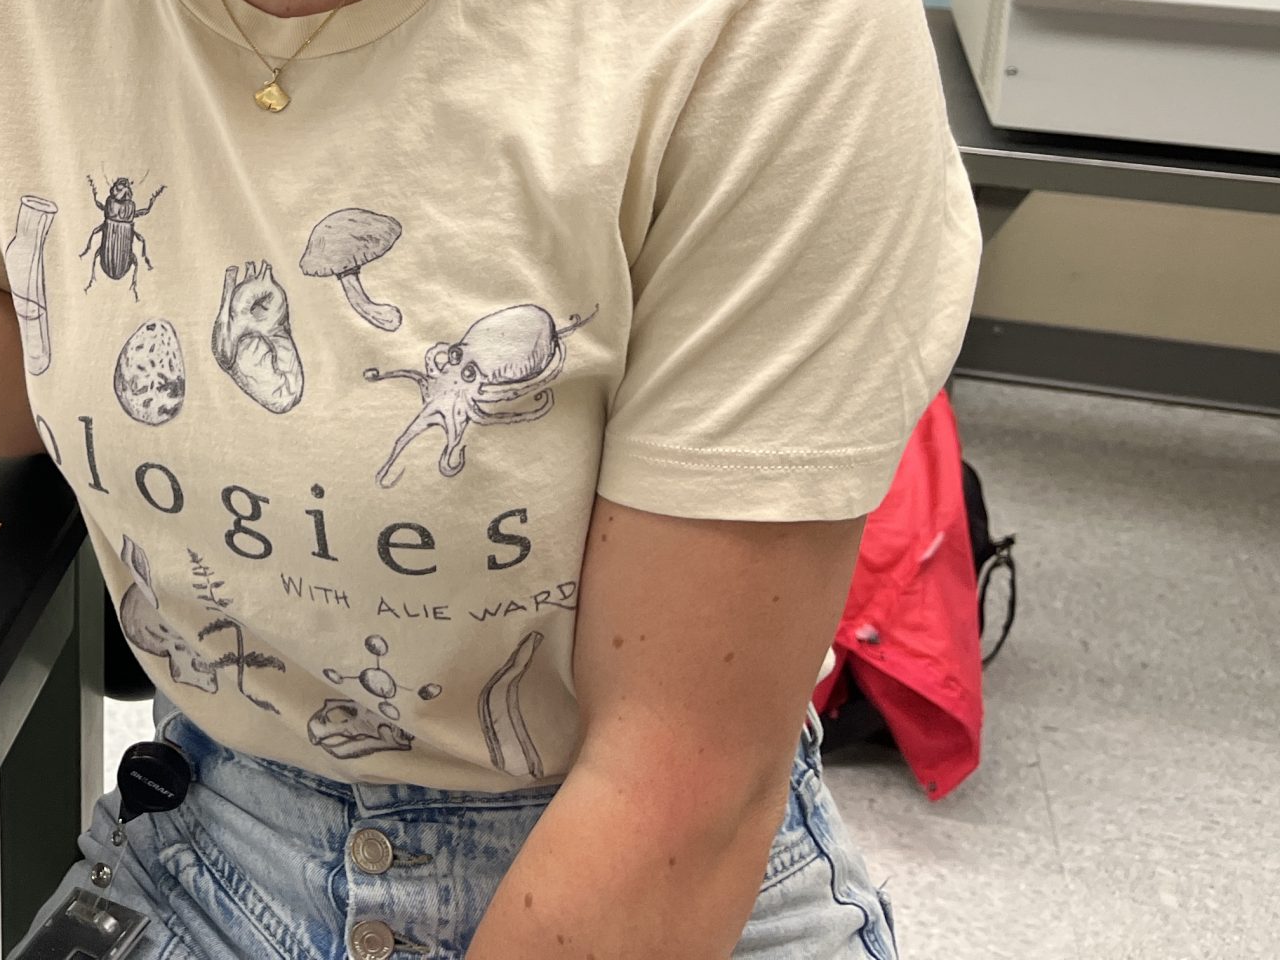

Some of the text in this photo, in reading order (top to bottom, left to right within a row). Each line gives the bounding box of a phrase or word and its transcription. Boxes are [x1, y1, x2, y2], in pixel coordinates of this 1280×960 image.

[280, 573, 577, 621] WITH ALIE WARD
